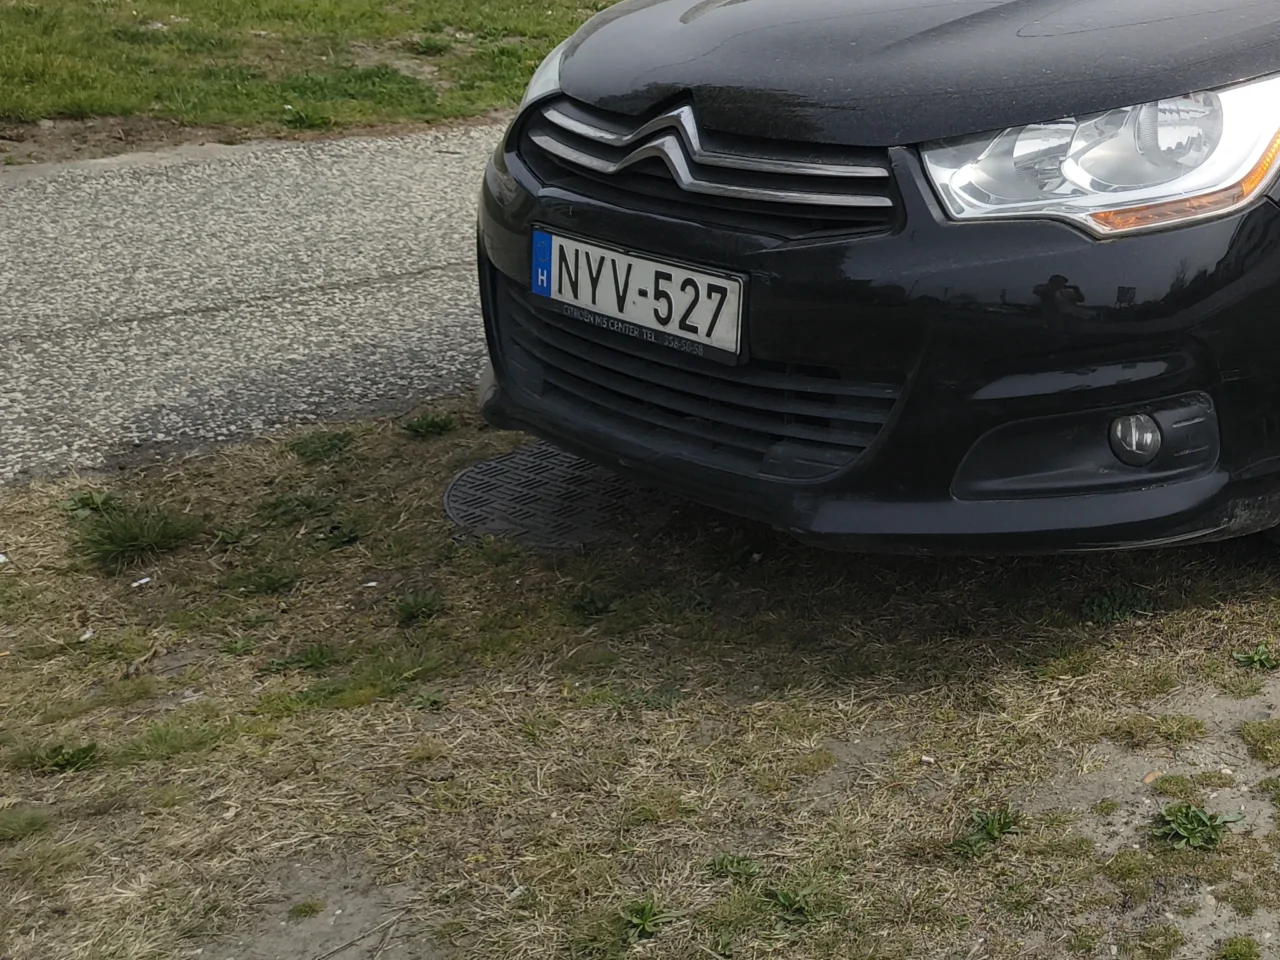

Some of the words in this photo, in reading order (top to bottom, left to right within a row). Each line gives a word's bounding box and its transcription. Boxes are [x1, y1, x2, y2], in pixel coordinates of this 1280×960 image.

[537, 267, 547, 288] H
[557, 243, 728, 339] NYV-527
[608, 319, 640, 337] CENTER
